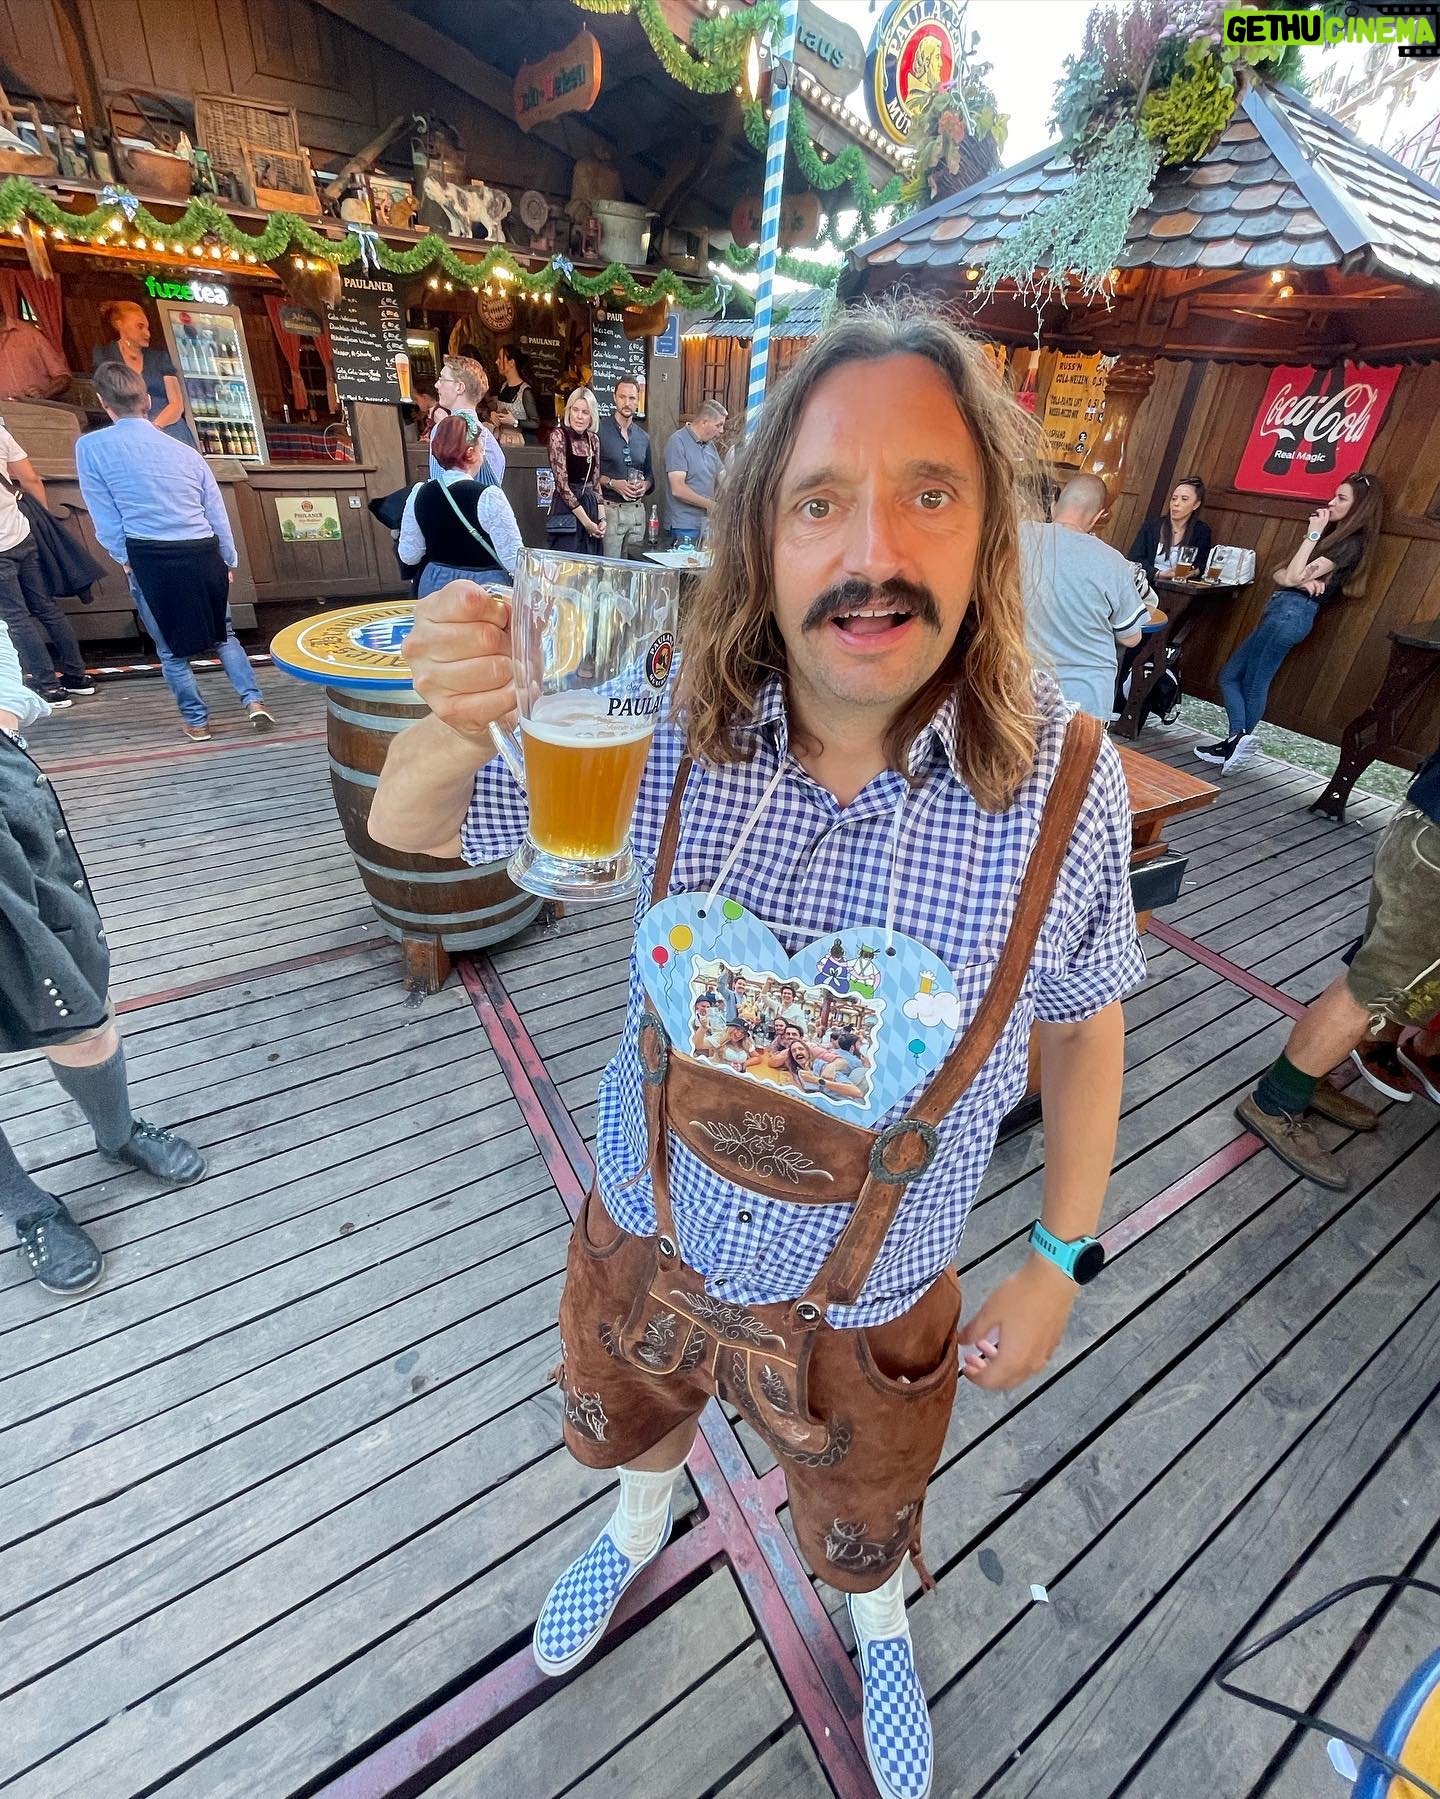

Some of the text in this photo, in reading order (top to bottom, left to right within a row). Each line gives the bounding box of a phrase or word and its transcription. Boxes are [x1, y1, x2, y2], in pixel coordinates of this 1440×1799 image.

[344, 277, 394, 292] PAULANER
[528, 337, 561, 347] PAULANER
[1260, 383, 1378, 444] Coca-Cola
[1274, 450, 1326, 462] Real Magic
